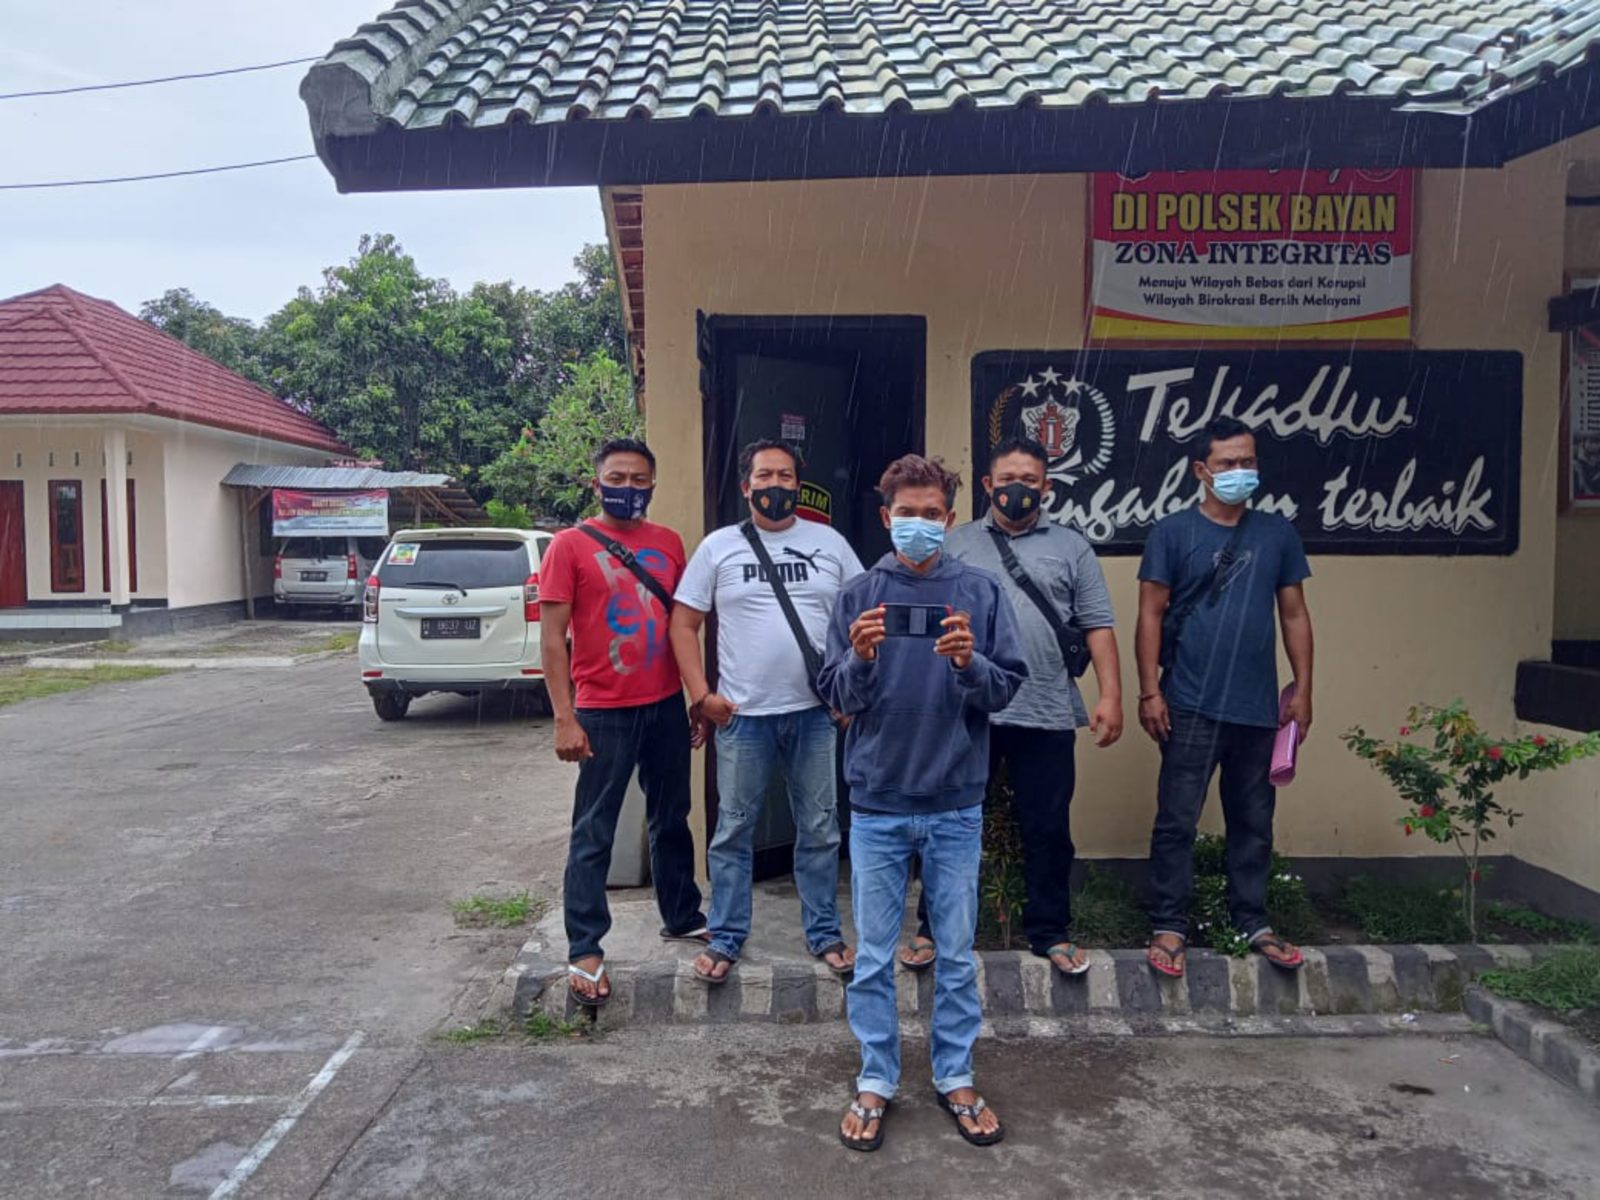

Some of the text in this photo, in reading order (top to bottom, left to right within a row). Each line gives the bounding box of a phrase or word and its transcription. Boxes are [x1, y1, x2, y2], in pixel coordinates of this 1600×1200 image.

[1112, 194, 1396, 232] DI POLSEK BAYAN
[1115, 243, 1391, 264] ZONA INTEGRITAS
[1138, 275, 1366, 290] Menuju Wilayah Bebas dari Korupsi
[1143, 292, 1361, 308] Wilayah Birokrasi Bersih Melayani
[800, 488, 828, 509] RIM
[1320, 455, 1495, 534] terbaik
[743, 562, 808, 582] PUMA
